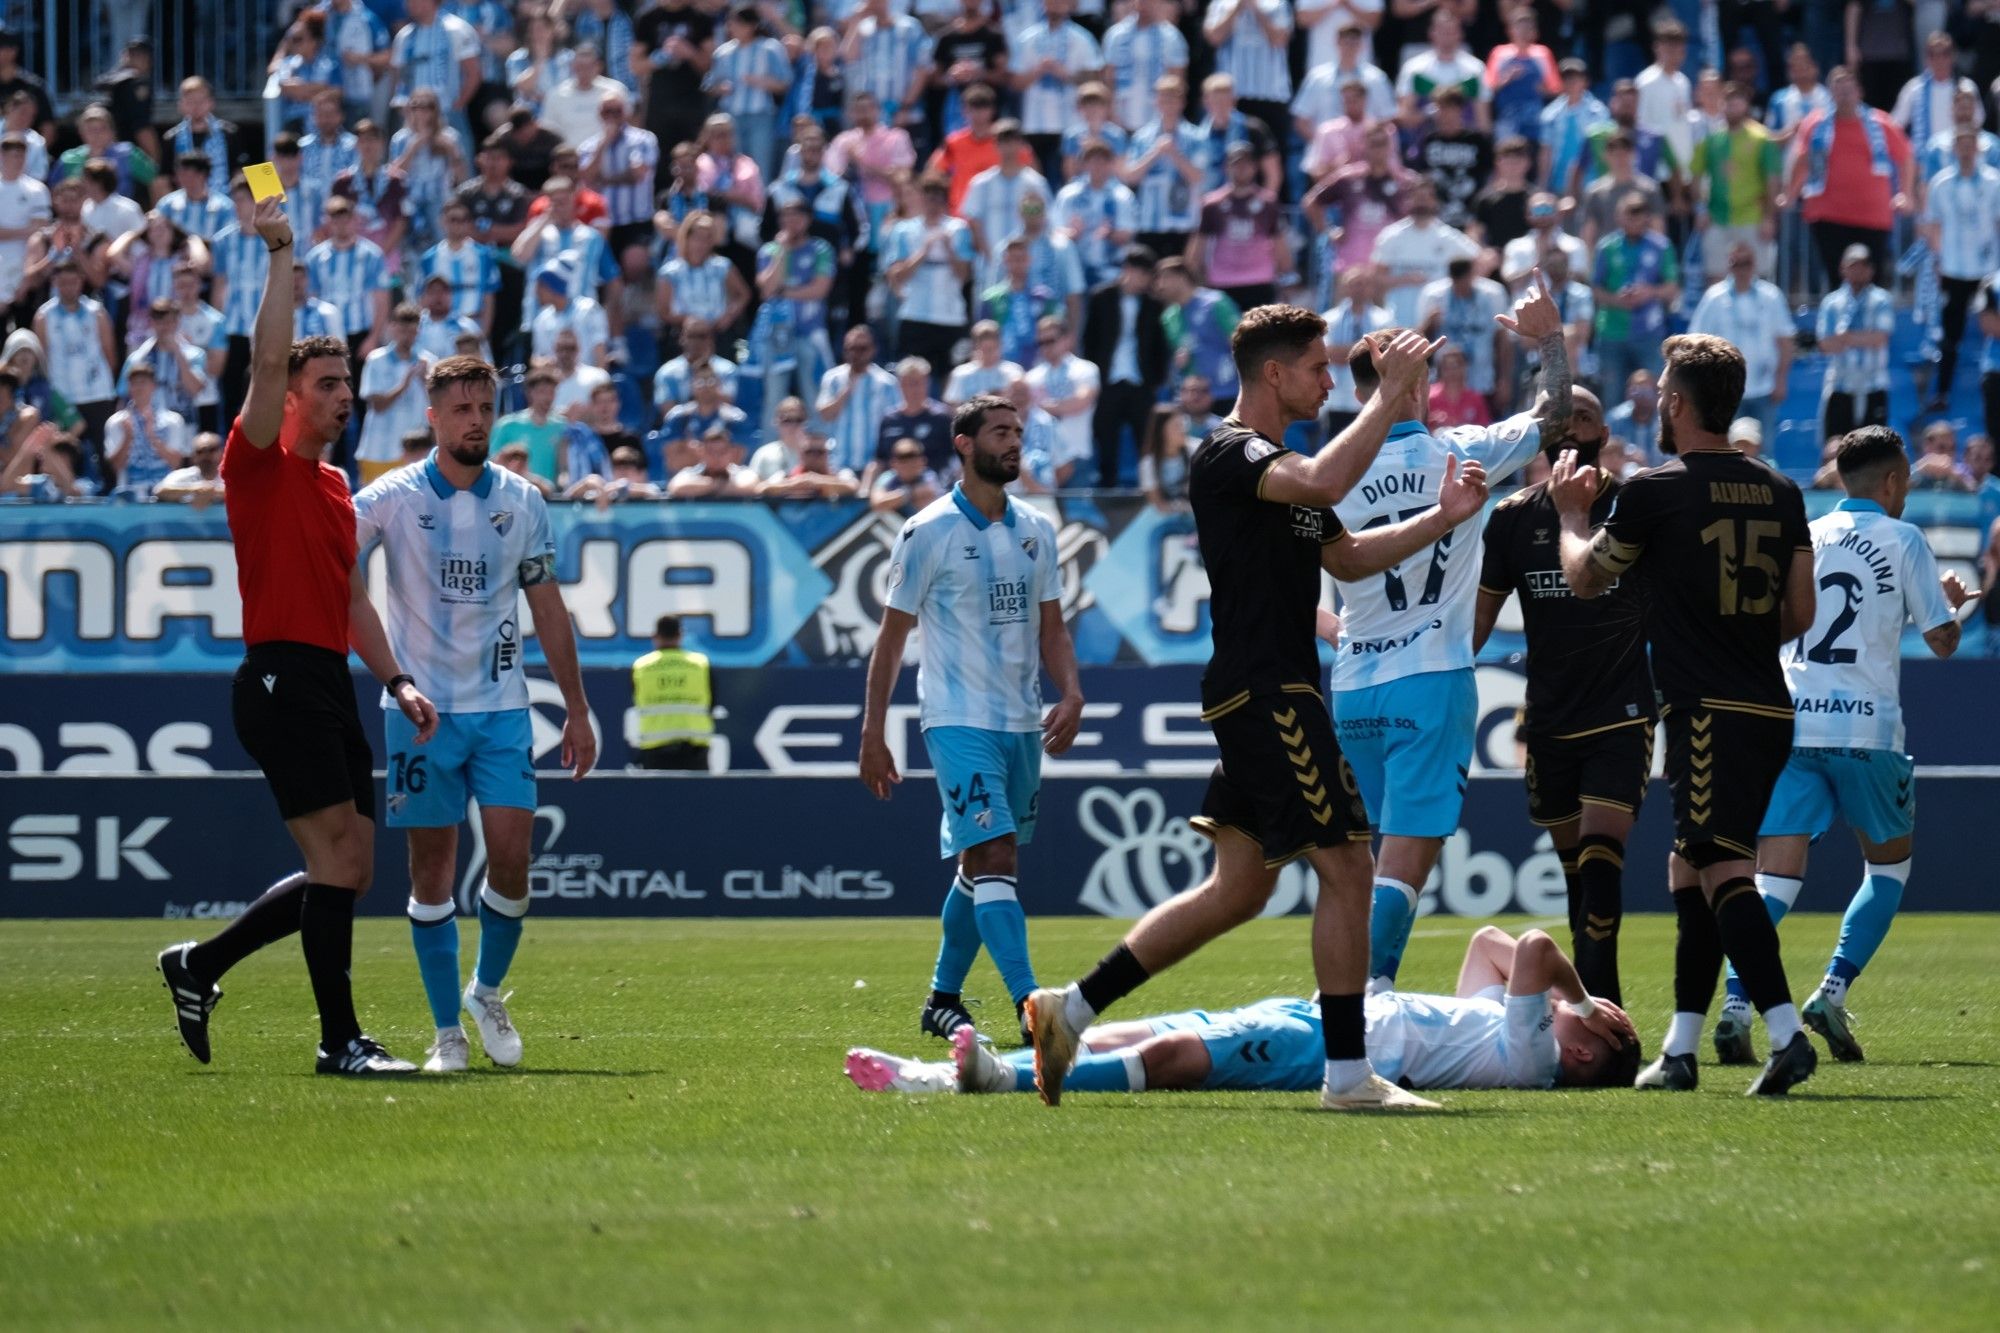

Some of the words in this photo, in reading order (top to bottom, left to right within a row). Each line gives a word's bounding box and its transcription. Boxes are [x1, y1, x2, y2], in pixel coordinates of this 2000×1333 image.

[1361, 472, 1425, 505] DIONI
[1709, 481, 1774, 505] ALVARO
[1700, 518, 1782, 616] 15
[1838, 531, 1895, 595] MOLINA
[440, 569, 487, 596] laga
[1532, 590, 1567, 599] COFFEE
[989, 591, 1028, 616] laga
[390, 751, 428, 794] 16
[967, 772, 991, 808] 4
[8, 814, 173, 881] SK
[528, 866, 708, 899] DENTAL
